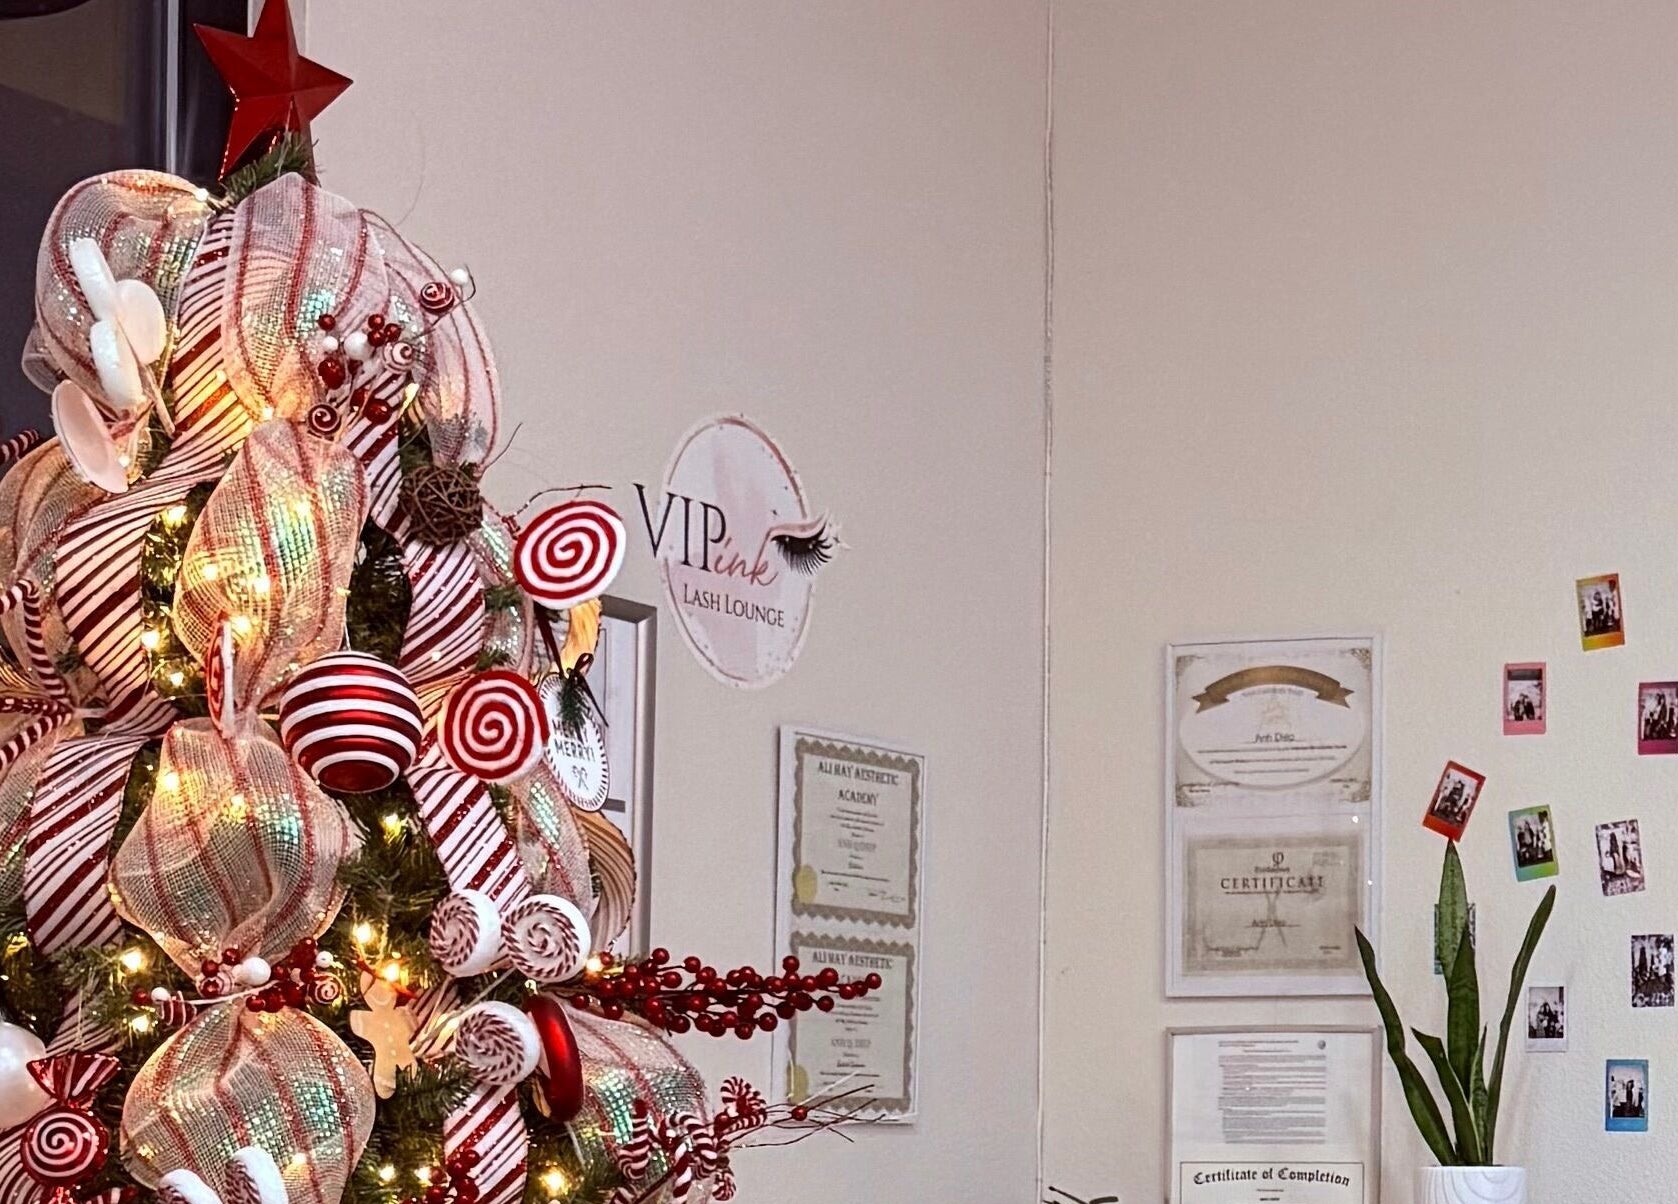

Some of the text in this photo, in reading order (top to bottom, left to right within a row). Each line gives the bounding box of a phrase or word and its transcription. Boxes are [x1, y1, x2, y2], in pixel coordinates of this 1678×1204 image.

[683, 583, 785, 628] LASH LOUNGE
[554, 738, 595, 763] MERRY!
[1220, 875, 1324, 890] CERTIFICATE
[1193, 1167, 1351, 1187] Certificate of Completion
